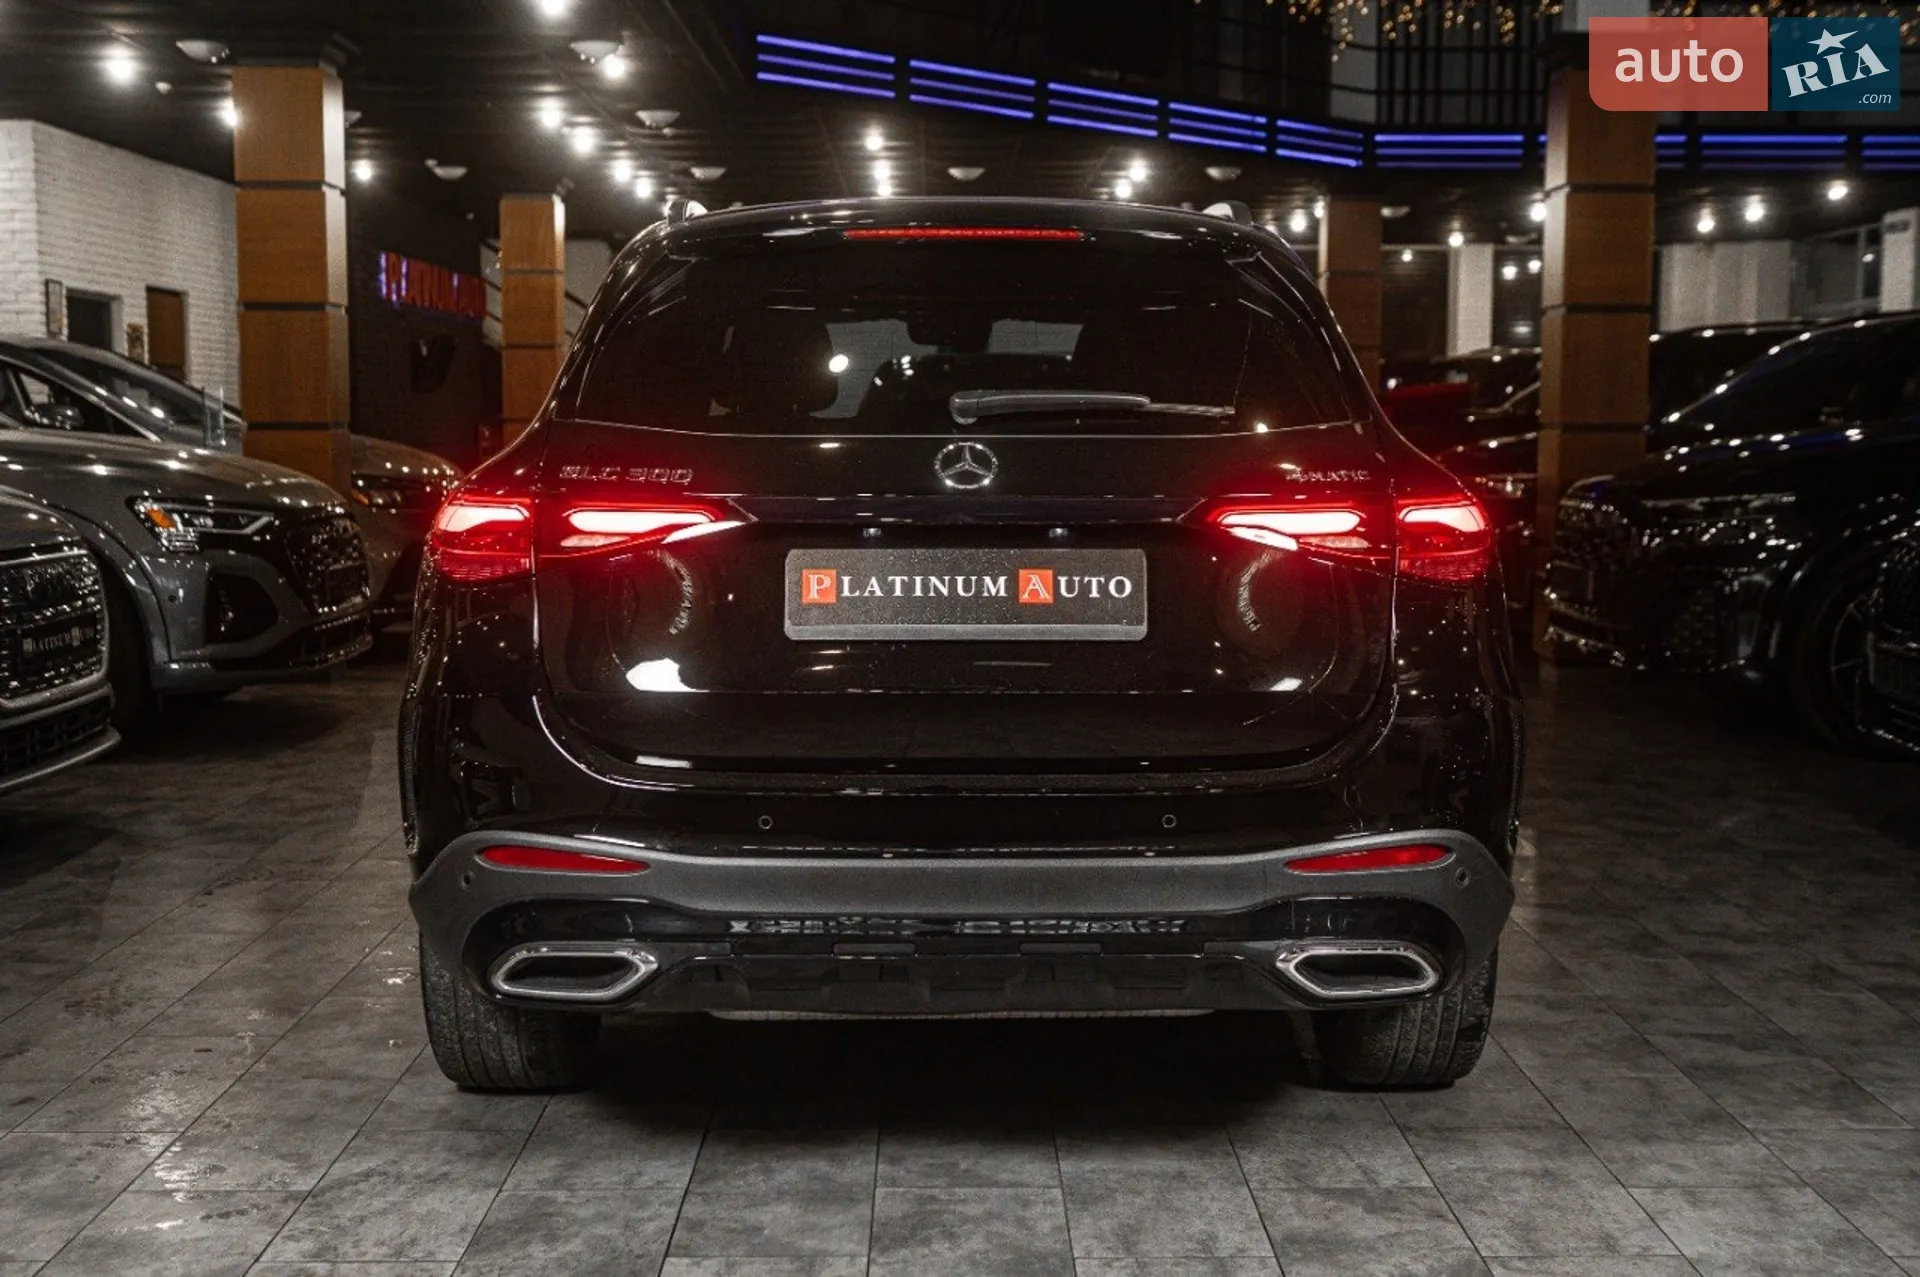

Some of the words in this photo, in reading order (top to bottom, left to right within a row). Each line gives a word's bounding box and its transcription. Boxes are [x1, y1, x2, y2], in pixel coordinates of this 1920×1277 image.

[559, 464, 621, 481] GLC
[626, 467, 693, 485] 300
[805, 573, 1008, 600] PLATINUM
[1022, 572, 1132, 600] AUTO
